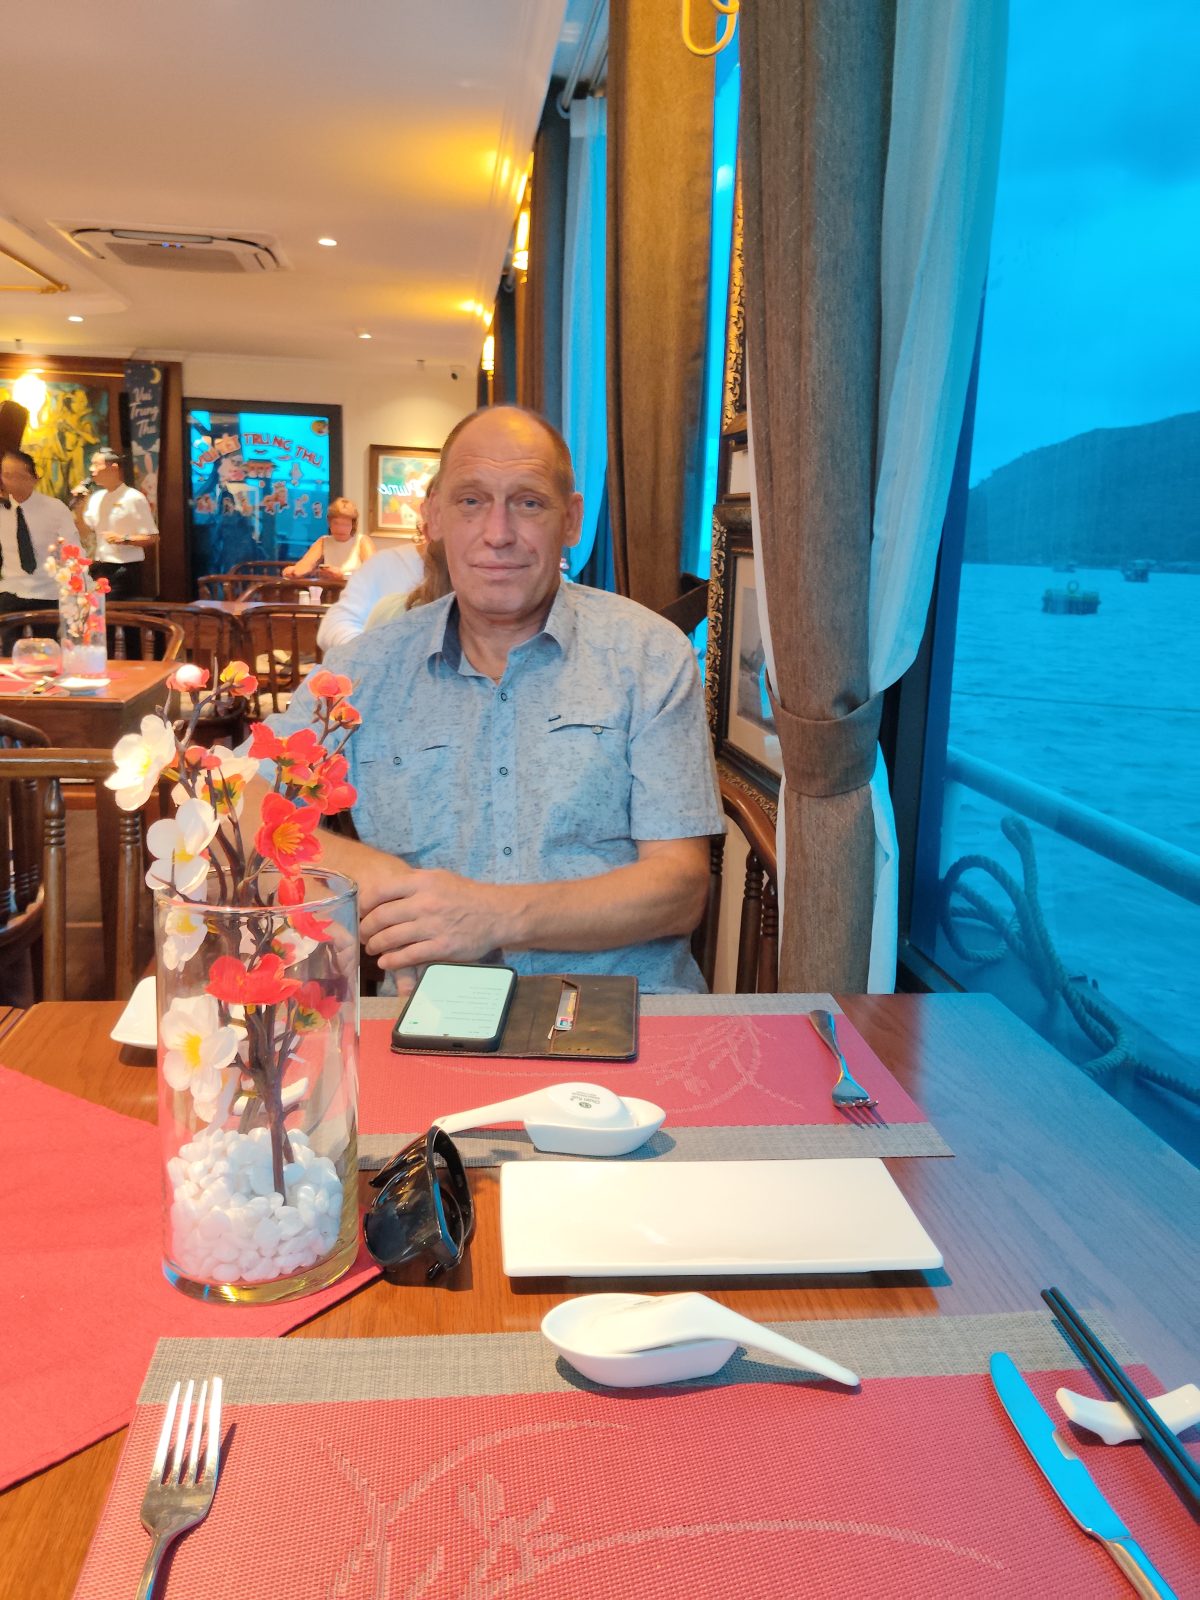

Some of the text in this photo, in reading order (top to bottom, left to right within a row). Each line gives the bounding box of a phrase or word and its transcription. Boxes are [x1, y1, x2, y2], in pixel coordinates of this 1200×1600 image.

[129, 402, 160, 421] Trung
[136, 419, 157, 437] Thu
[295, 445, 323, 467] THU
